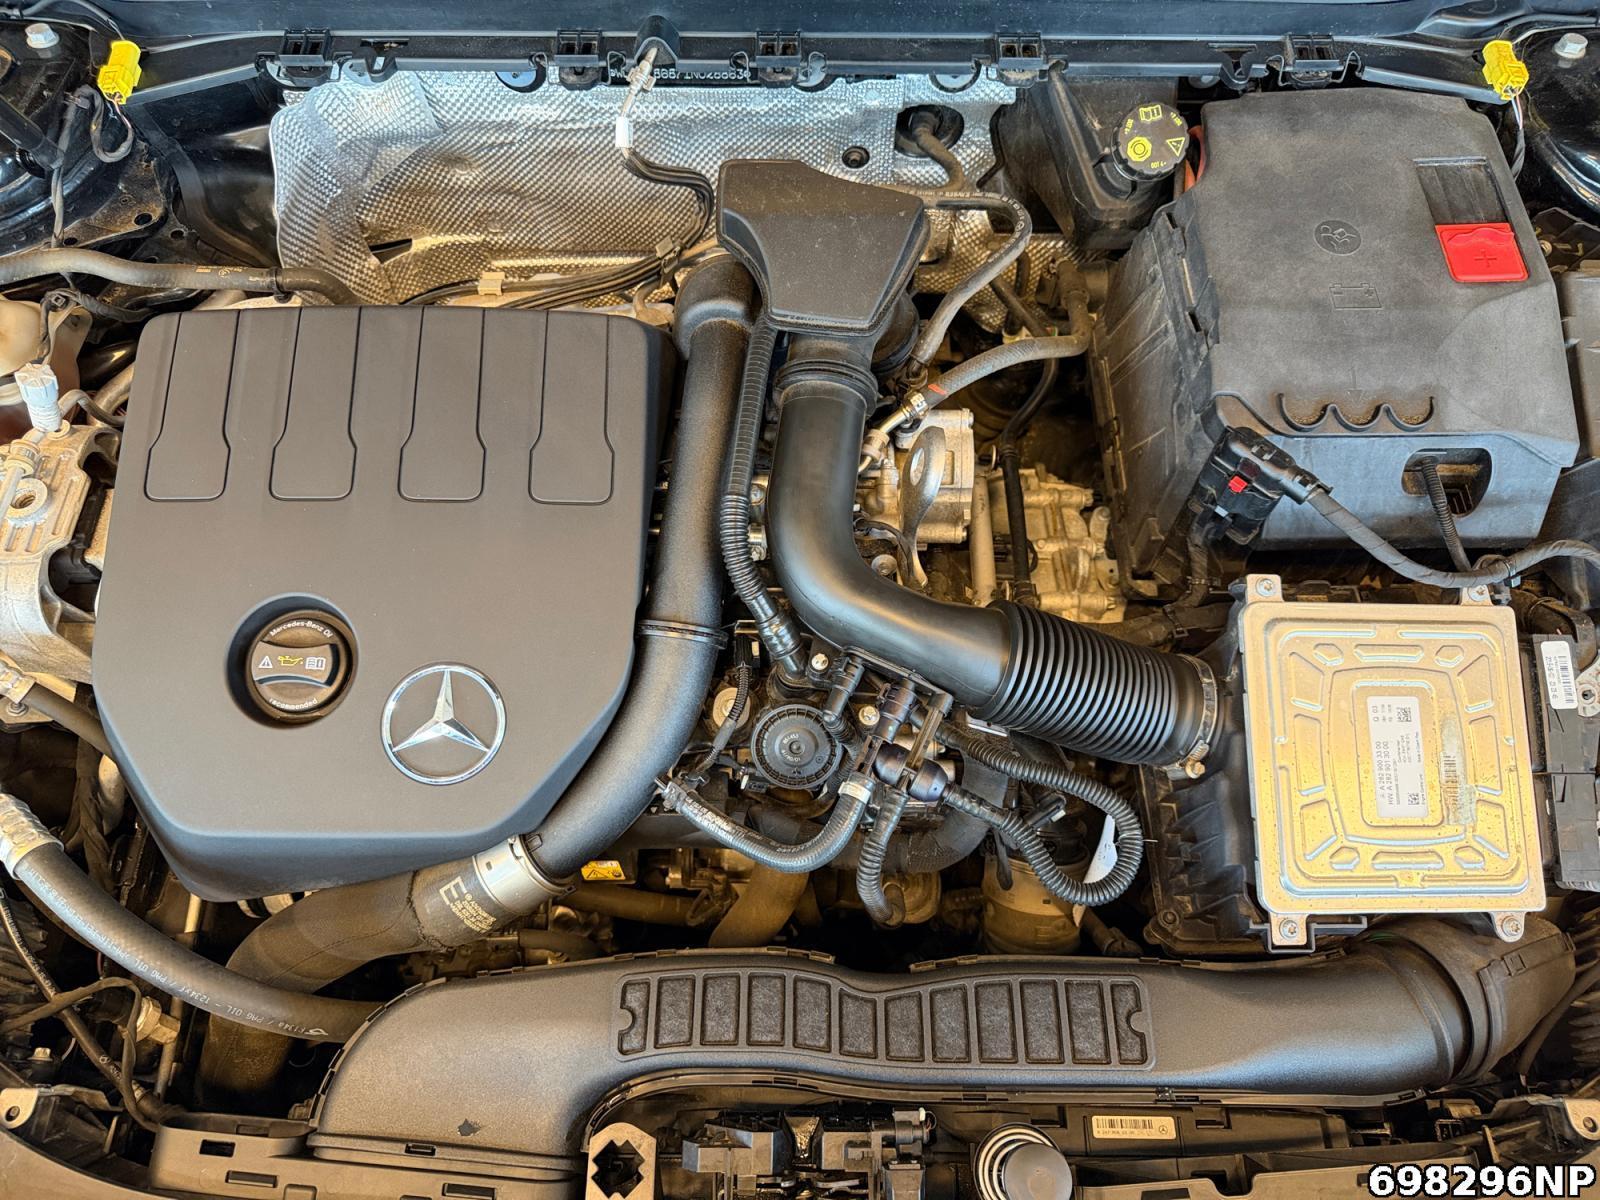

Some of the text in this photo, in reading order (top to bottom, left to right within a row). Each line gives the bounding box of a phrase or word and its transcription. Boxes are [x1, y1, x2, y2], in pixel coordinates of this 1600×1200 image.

[269, 620, 325, 637] Mercedes-Benz
[269, 697, 318, 710] recommended
[1375, 740, 1382, 750] 00
[1382, 740, 1390, 750] 00
[1376, 759, 1384, 771] 900
[134, 958, 149, 972] OIL
[150, 969, 168, 983] PAG
[227, 1005, 243, 1016] OIL
[246, 1013, 265, 1023] PAG
